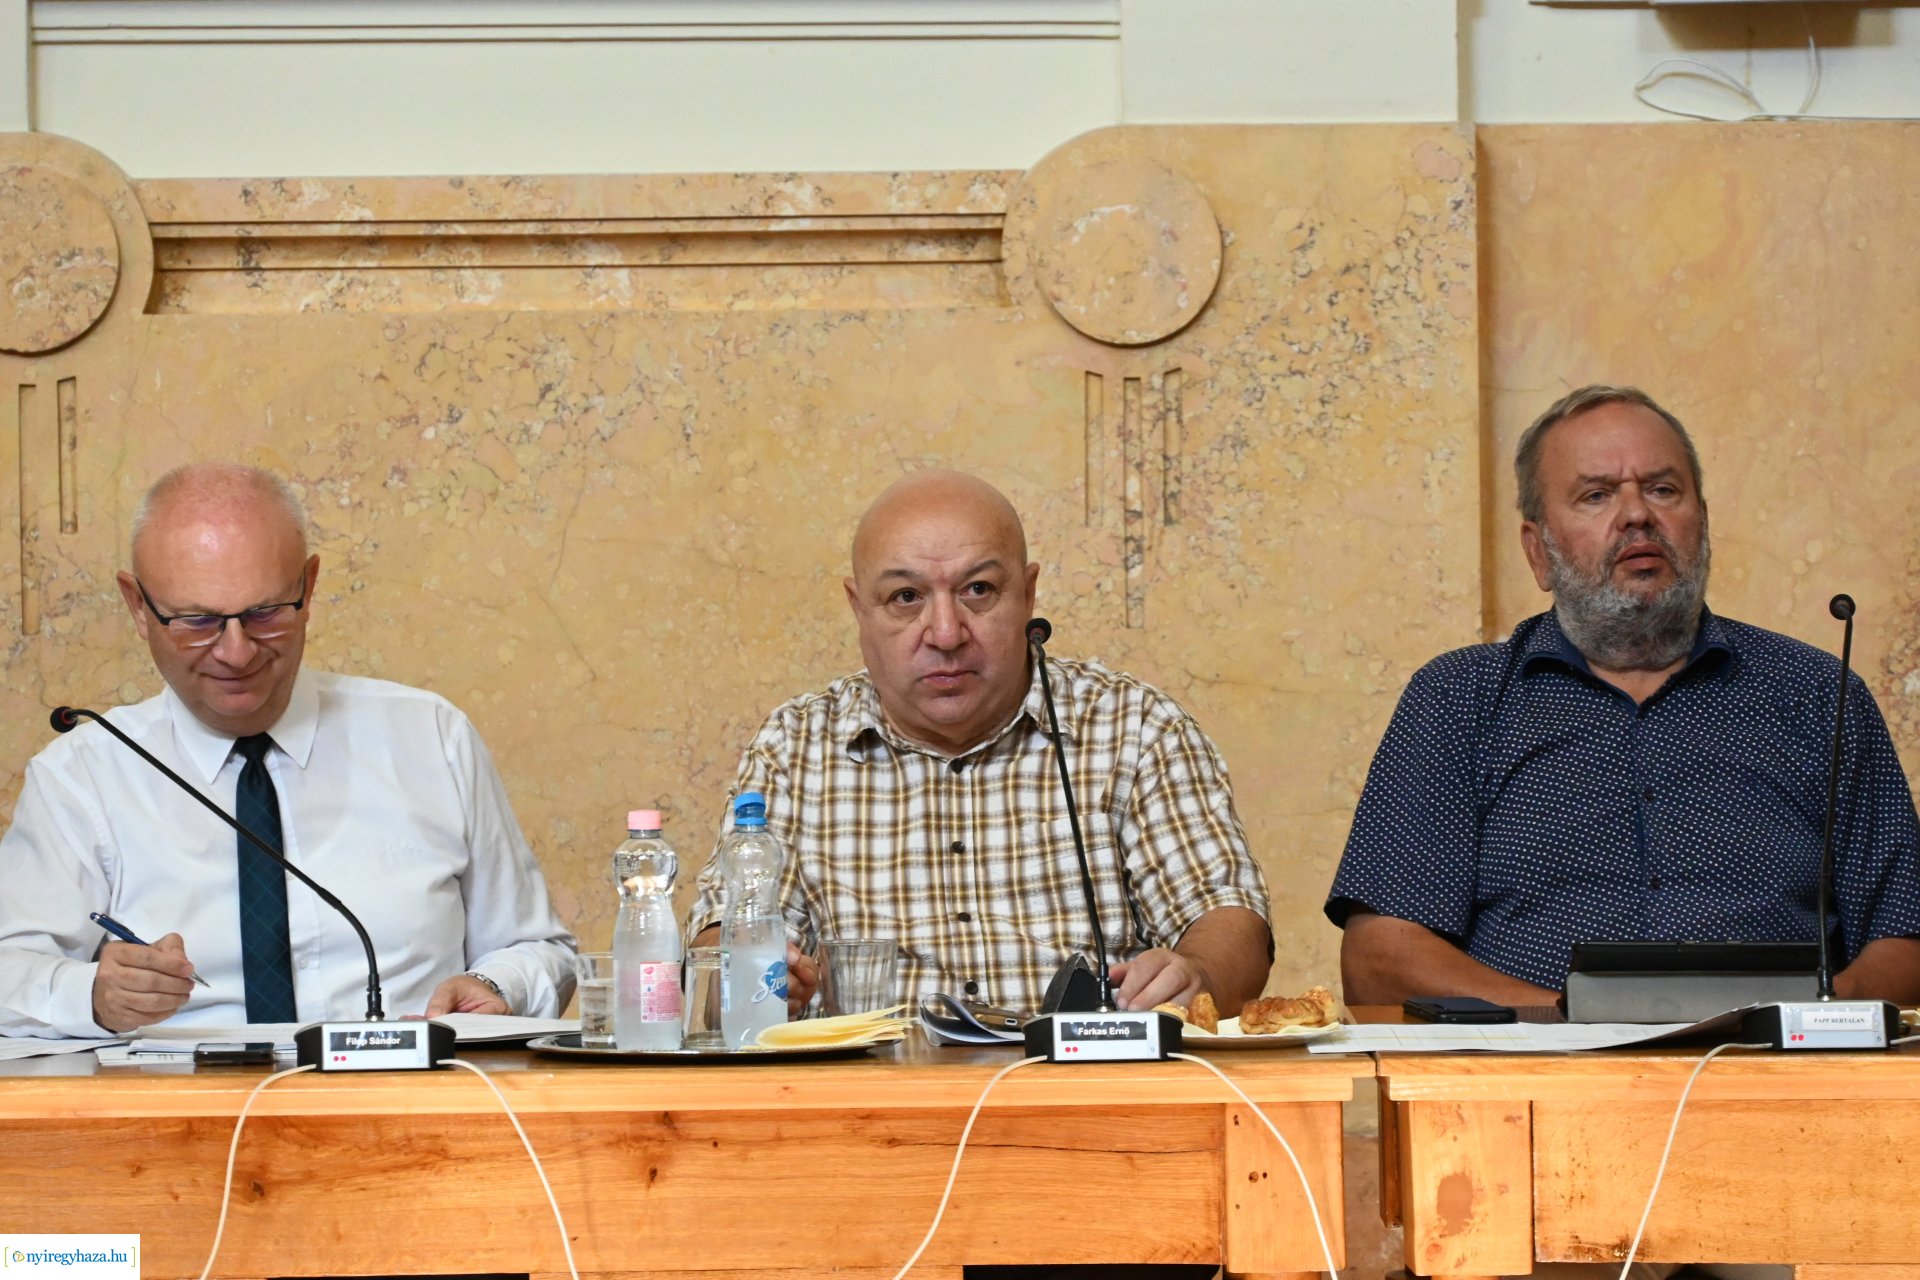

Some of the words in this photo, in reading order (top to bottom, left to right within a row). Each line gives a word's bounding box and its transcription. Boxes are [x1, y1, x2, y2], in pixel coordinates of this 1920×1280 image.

[1078, 1027, 1108, 1036] Farkas
[1109, 1026, 1130, 1036] Ernő
[369, 1036, 401, 1046] Sándor
